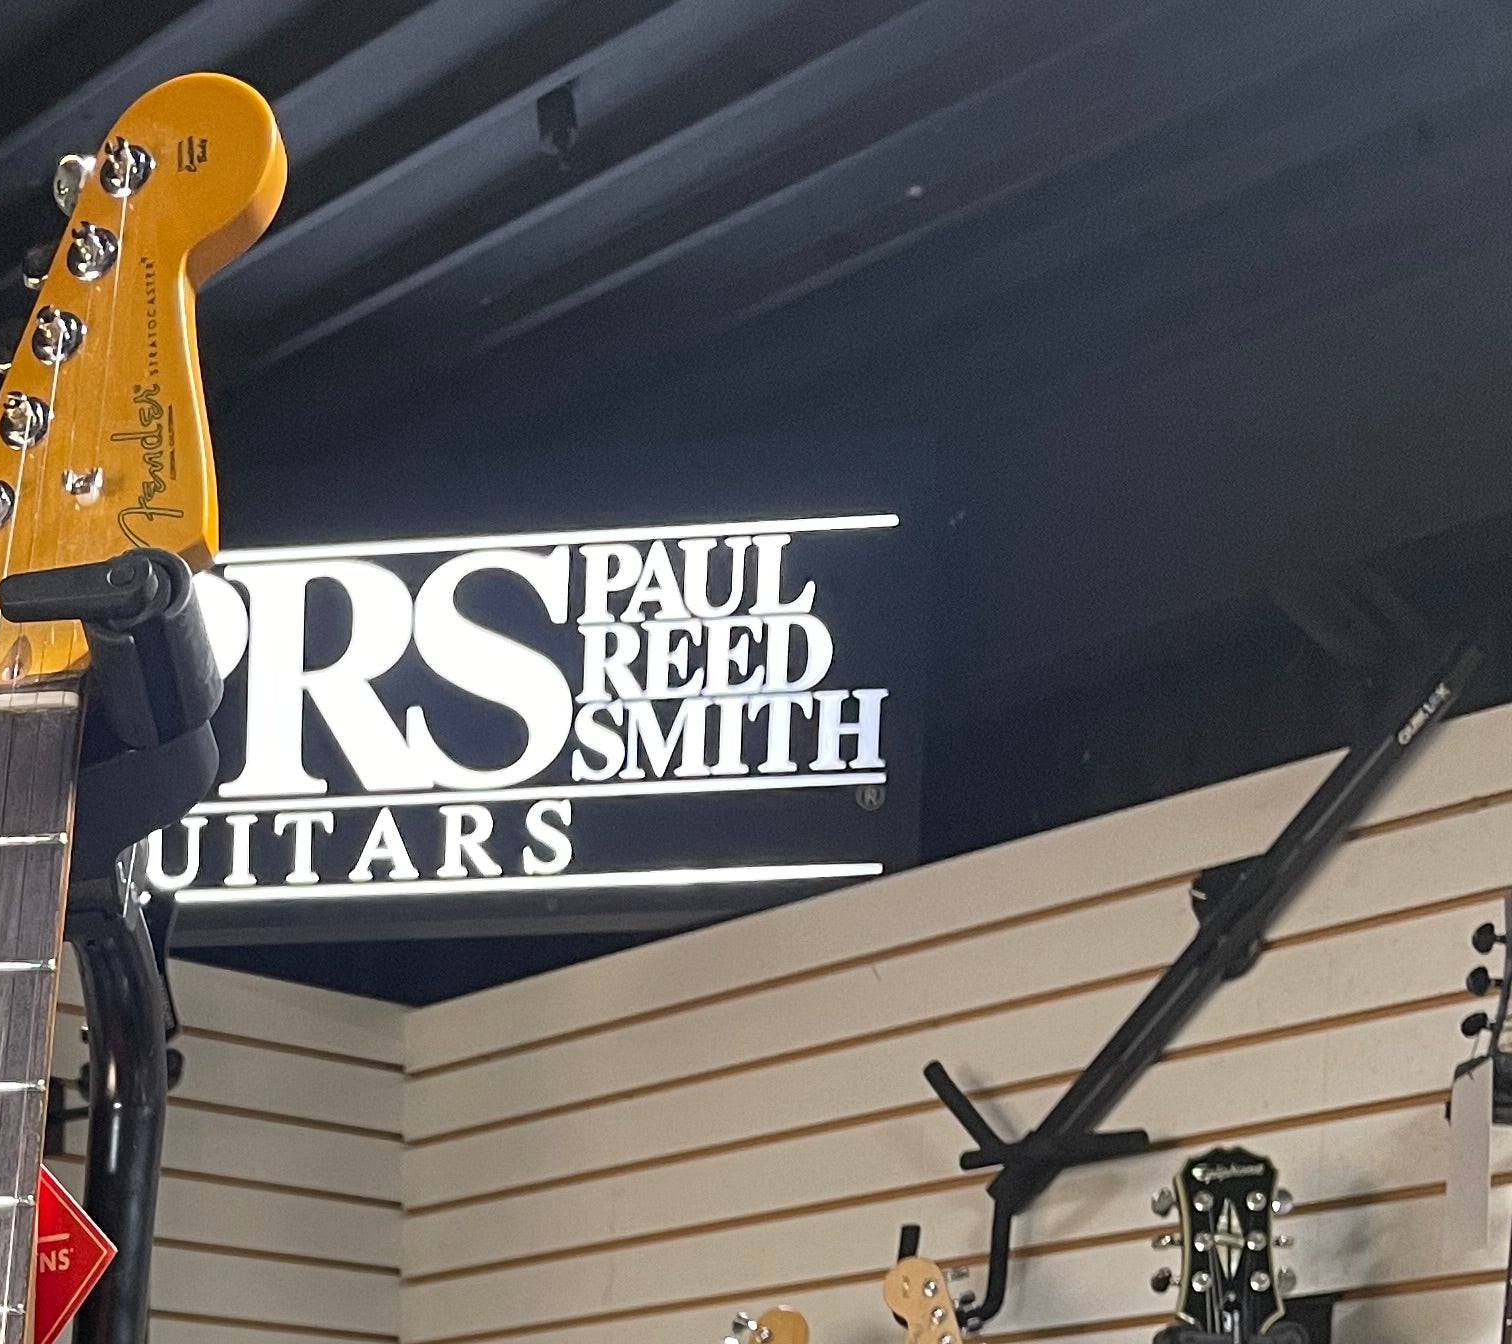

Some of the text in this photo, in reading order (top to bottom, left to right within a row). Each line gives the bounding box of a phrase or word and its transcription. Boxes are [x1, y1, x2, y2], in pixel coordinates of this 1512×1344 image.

[147, 259, 161, 377] STRATOCASTER
[109, 383, 185, 548] Fender
[577, 534, 816, 625] PAUL
[575, 614, 835, 704] REED
[571, 689, 889, 783] SMITH
[145, 800, 573, 891] UITARS
